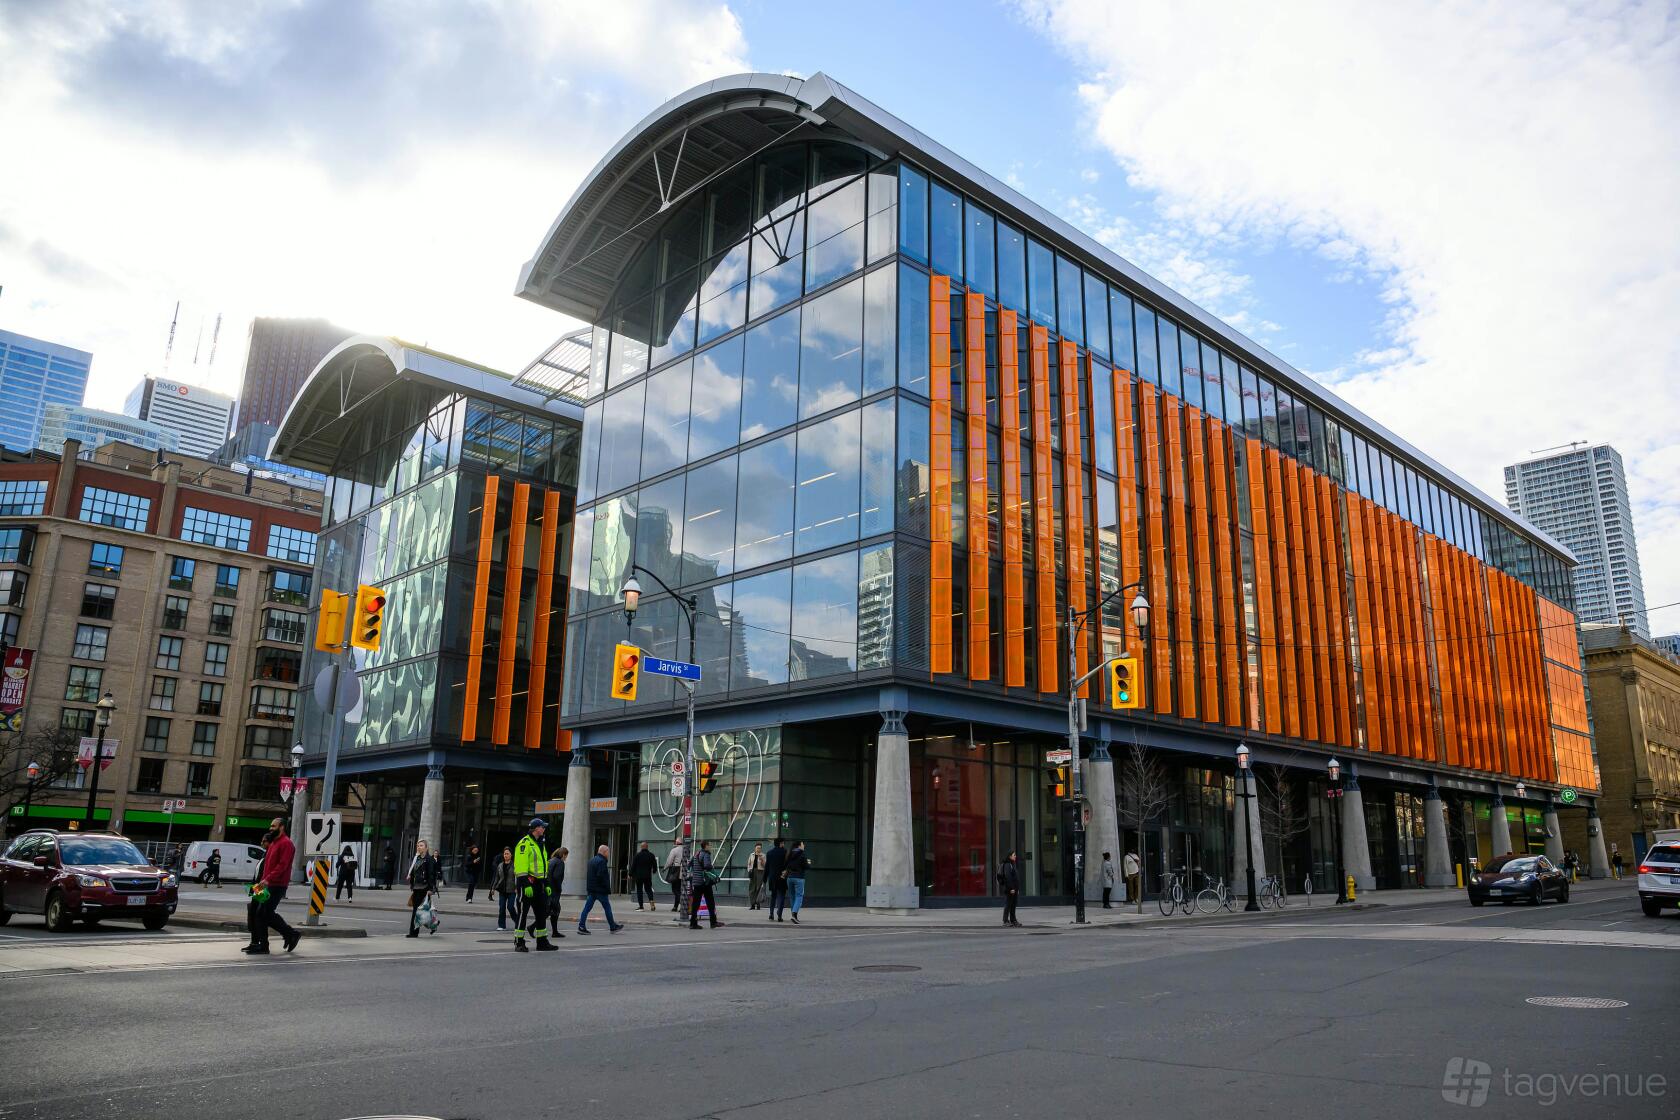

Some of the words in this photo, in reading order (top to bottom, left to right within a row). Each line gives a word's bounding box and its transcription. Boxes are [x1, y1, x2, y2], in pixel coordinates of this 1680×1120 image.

[157, 381, 177, 391] BMO
[658, 661, 682, 674] Jarvis
[1, 688, 23, 699] OPEN
[1565, 791, 1572, 799] P
[13, 806, 24, 814] TD
[228, 817, 238, 825] TD
